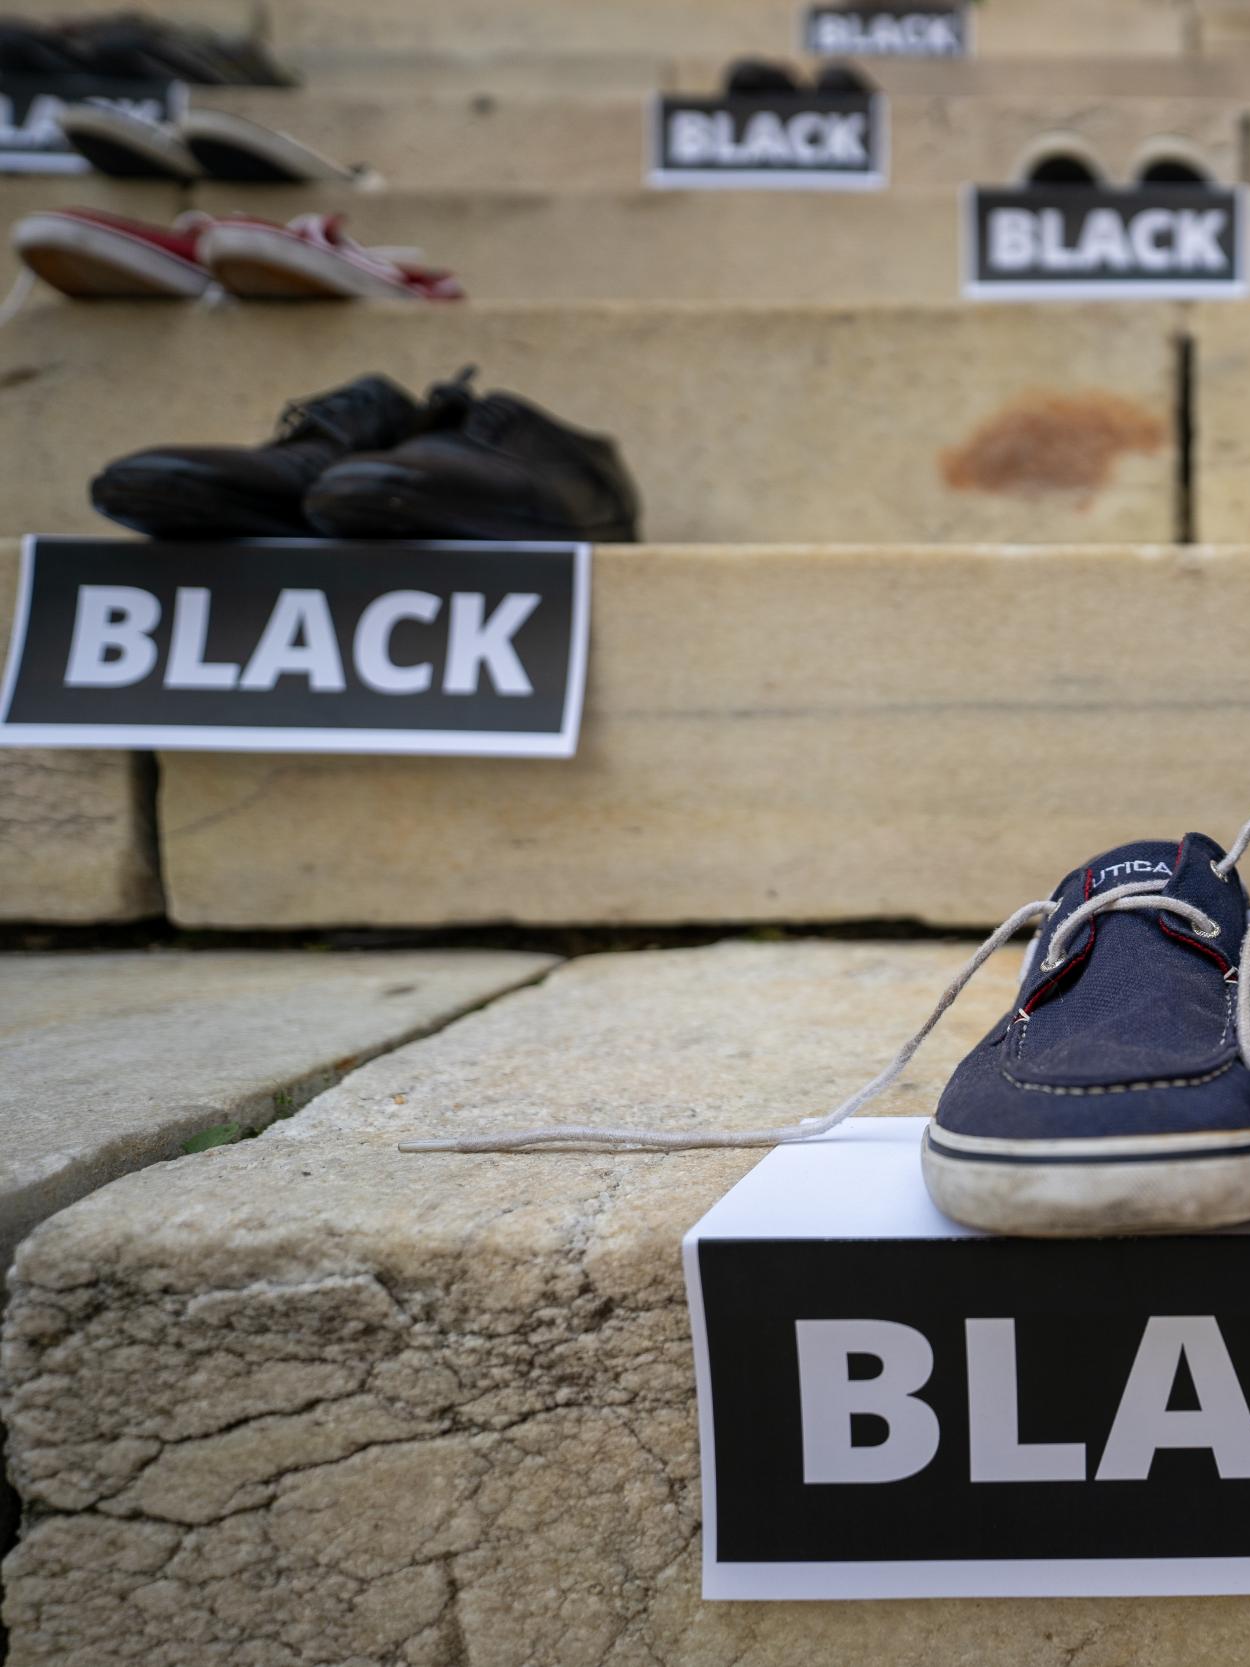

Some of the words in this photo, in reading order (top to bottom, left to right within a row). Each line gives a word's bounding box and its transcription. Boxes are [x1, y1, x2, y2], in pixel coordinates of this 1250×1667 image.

[816, 12, 960, 54] BLACK
[667, 111, 867, 163] BLACK
[989, 209, 1227, 271] BLACK
[64, 584, 540, 697] BLACK
